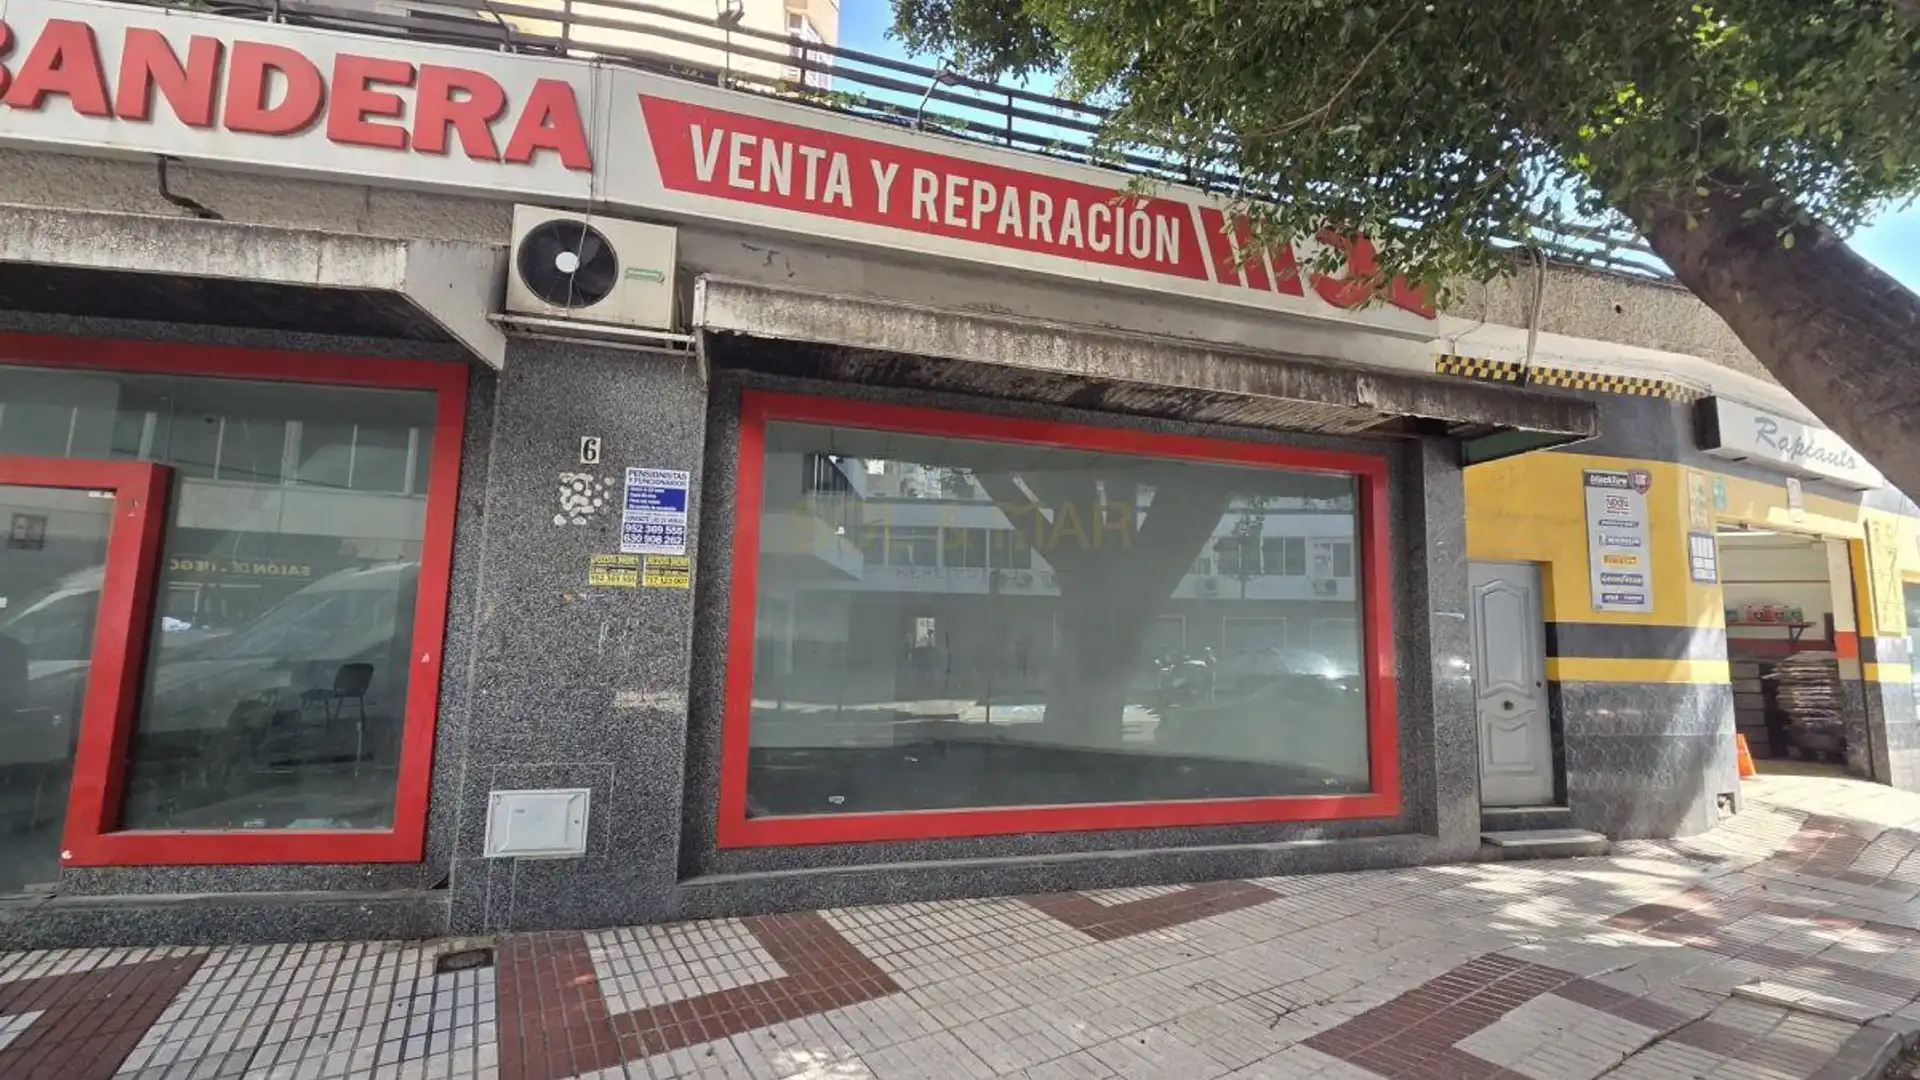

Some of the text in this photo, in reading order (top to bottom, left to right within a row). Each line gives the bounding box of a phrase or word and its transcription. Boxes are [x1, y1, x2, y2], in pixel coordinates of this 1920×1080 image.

[0, 18, 593, 173] ANDERA
[690, 123, 1181, 266] VENTA Y REPARACIÓN
[583, 438, 597, 462] 6
